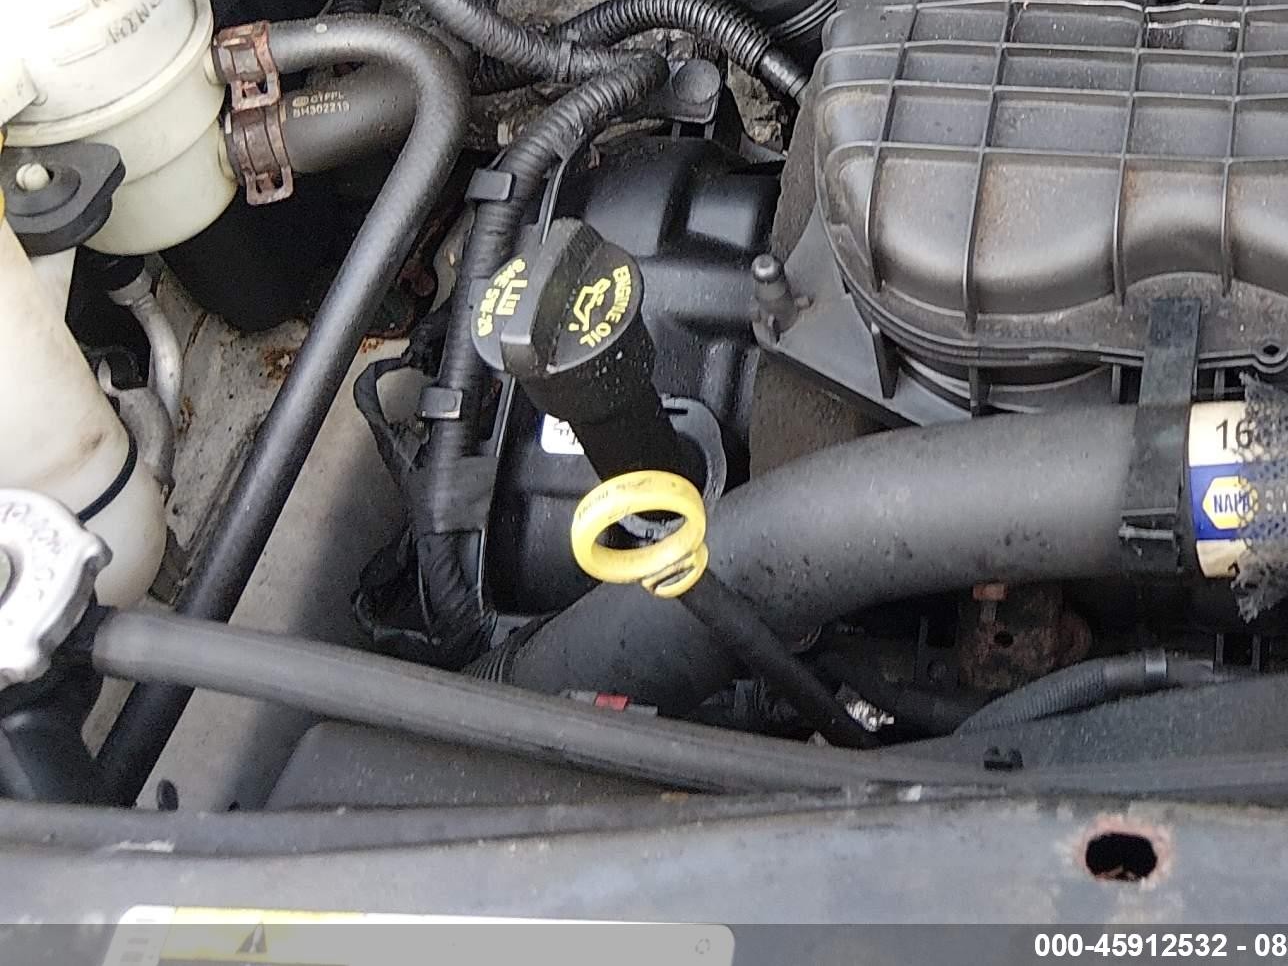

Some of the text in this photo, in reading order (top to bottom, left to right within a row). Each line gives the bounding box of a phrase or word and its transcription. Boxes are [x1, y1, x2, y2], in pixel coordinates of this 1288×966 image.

[579, 265, 632, 348] ENGINE OIL
[1213, 492, 1251, 514] NAPA
